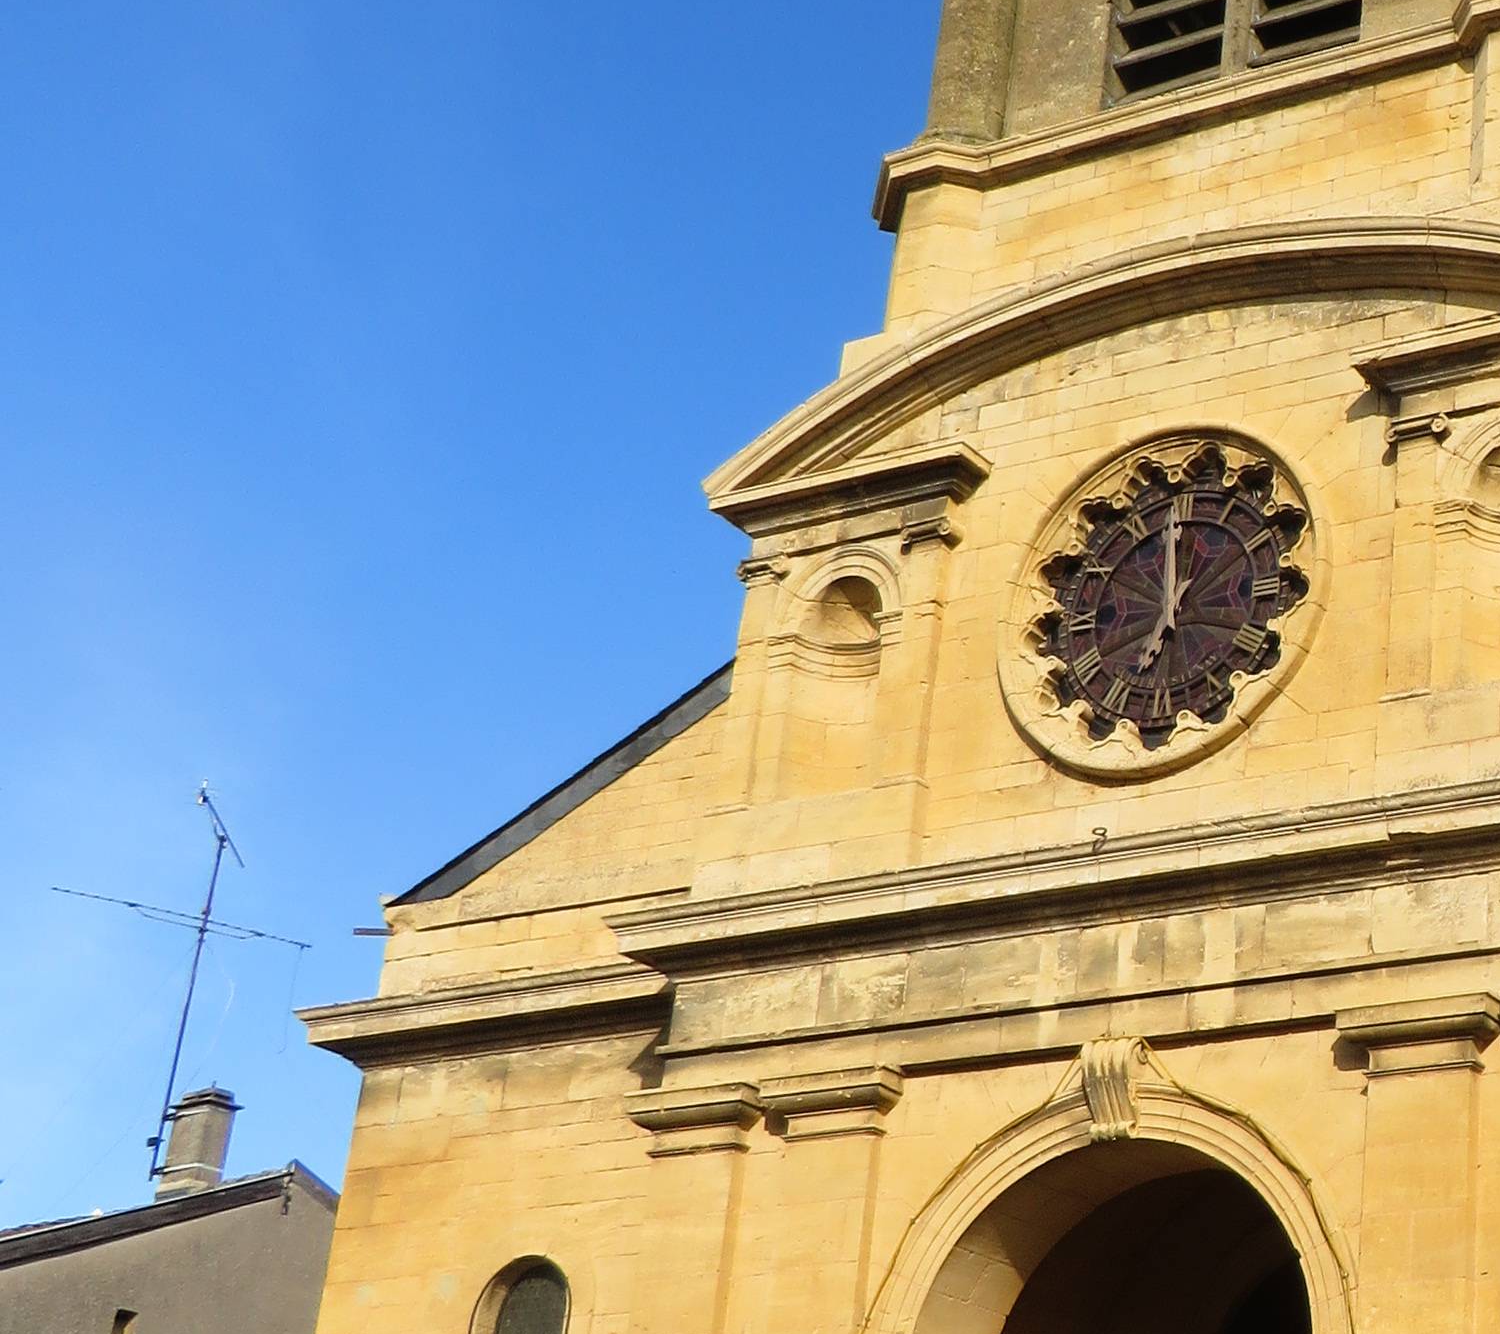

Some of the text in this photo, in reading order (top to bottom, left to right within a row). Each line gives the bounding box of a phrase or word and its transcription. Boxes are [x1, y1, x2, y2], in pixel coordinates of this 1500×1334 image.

[1218, 497, 1236, 524] I
[1116, 515, 1150, 543] XI
[1243, 528, 1273, 554] II
[1086, 557, 1115, 581] X
[1251, 576, 1280, 598] III
[1069, 610, 1097, 632] IX
[1072, 647, 1104, 686] VIII
[1101, 677, 1132, 714] VII
[1205, 670, 1224, 698] V
[1152, 688, 1173, 717] VI
